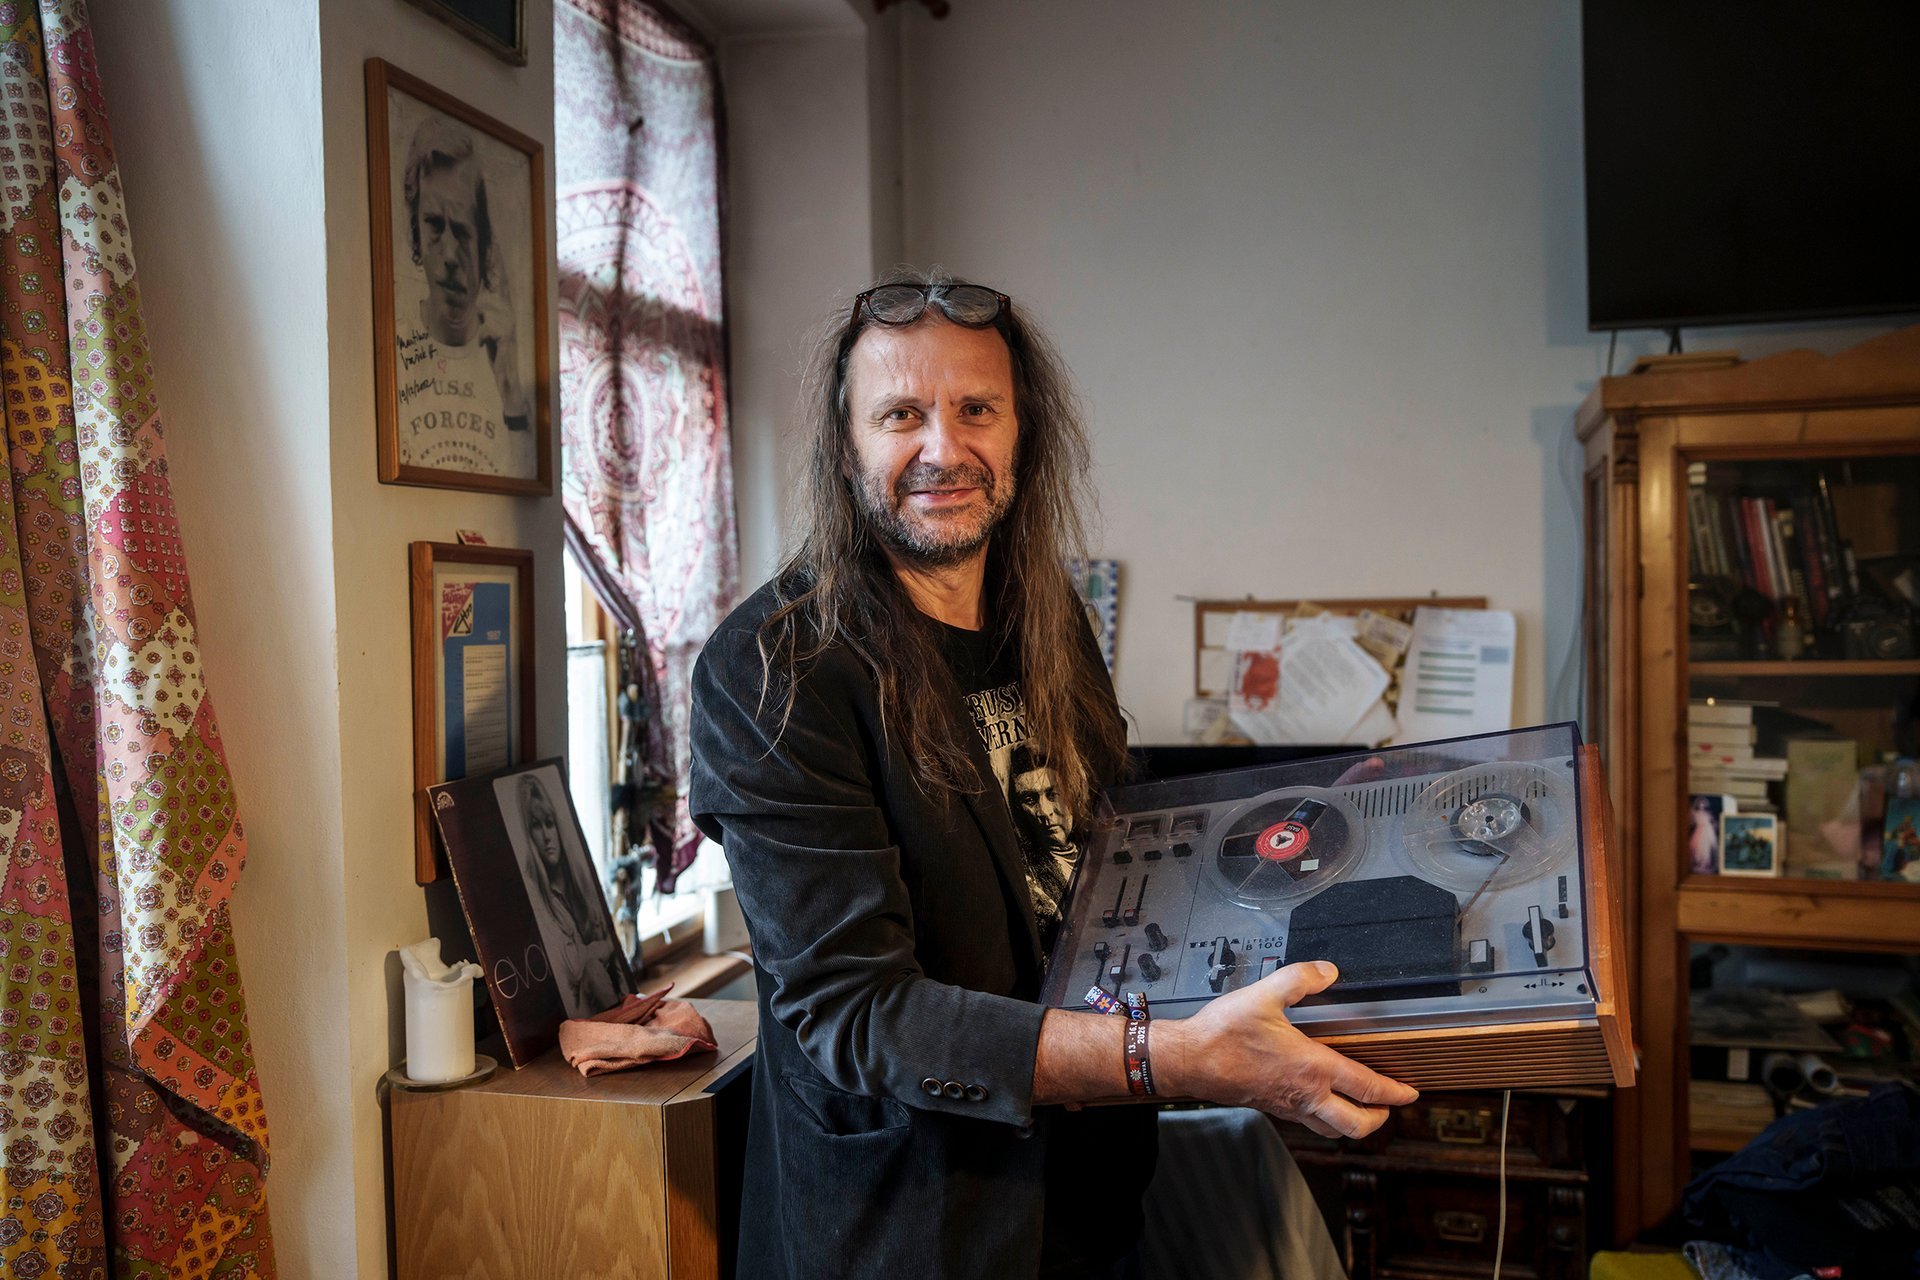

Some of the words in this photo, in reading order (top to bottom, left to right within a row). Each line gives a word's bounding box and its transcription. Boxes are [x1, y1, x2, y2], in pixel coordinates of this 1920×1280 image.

[410, 411, 495, 439] FORCES
[963, 681, 1024, 721] RUST
[1189, 938, 1240, 949] TESA
